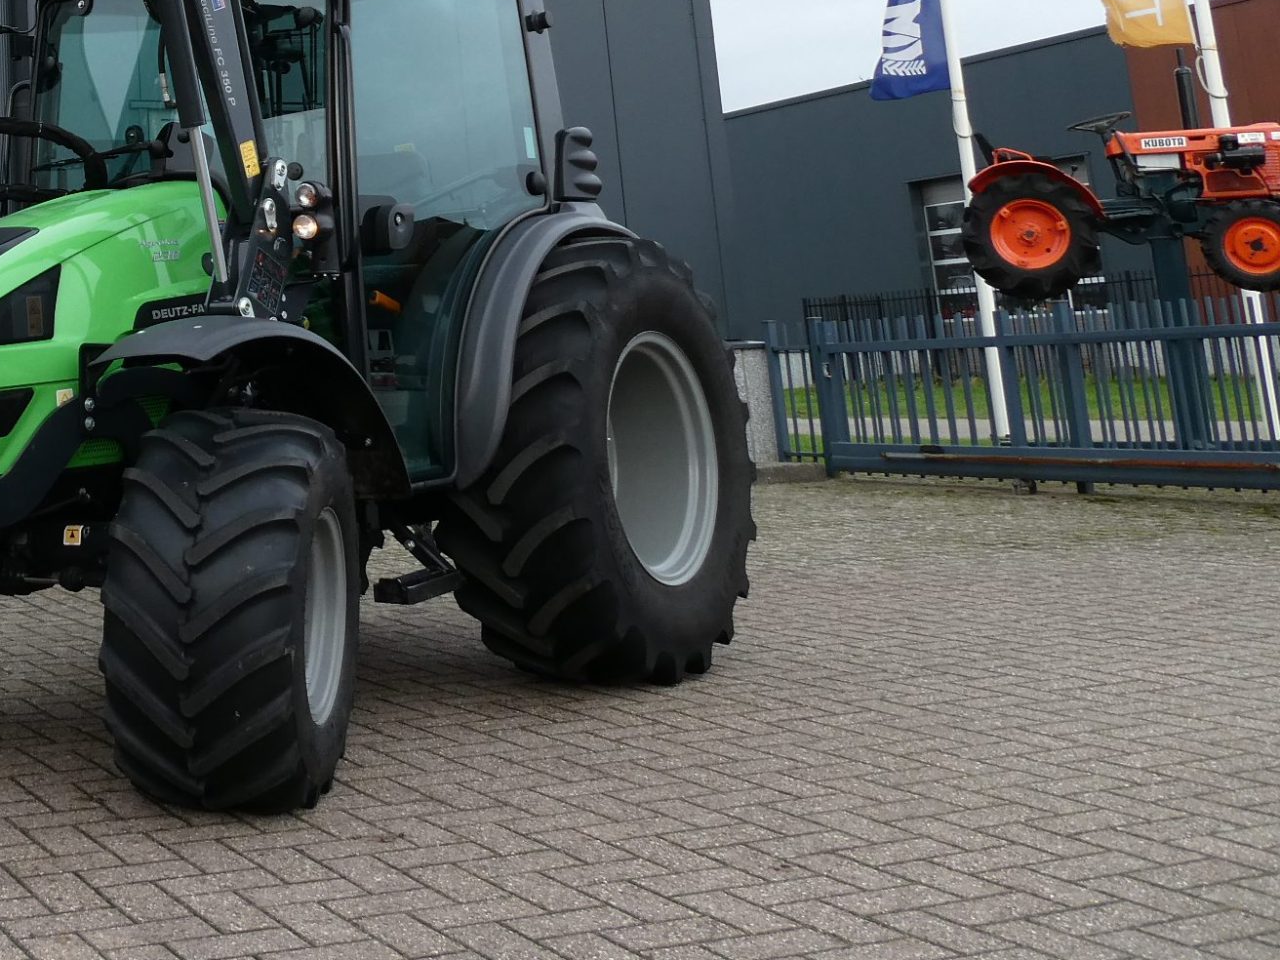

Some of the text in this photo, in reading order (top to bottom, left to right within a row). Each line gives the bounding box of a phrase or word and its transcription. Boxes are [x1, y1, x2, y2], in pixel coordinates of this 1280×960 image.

[214, 48, 224, 66] FC
[221, 70, 233, 94] 350
[228, 97, 236, 106] P
[1144, 137, 1184, 148] KUBOTA
[152, 303, 205, 320] DEUTZ-FA
